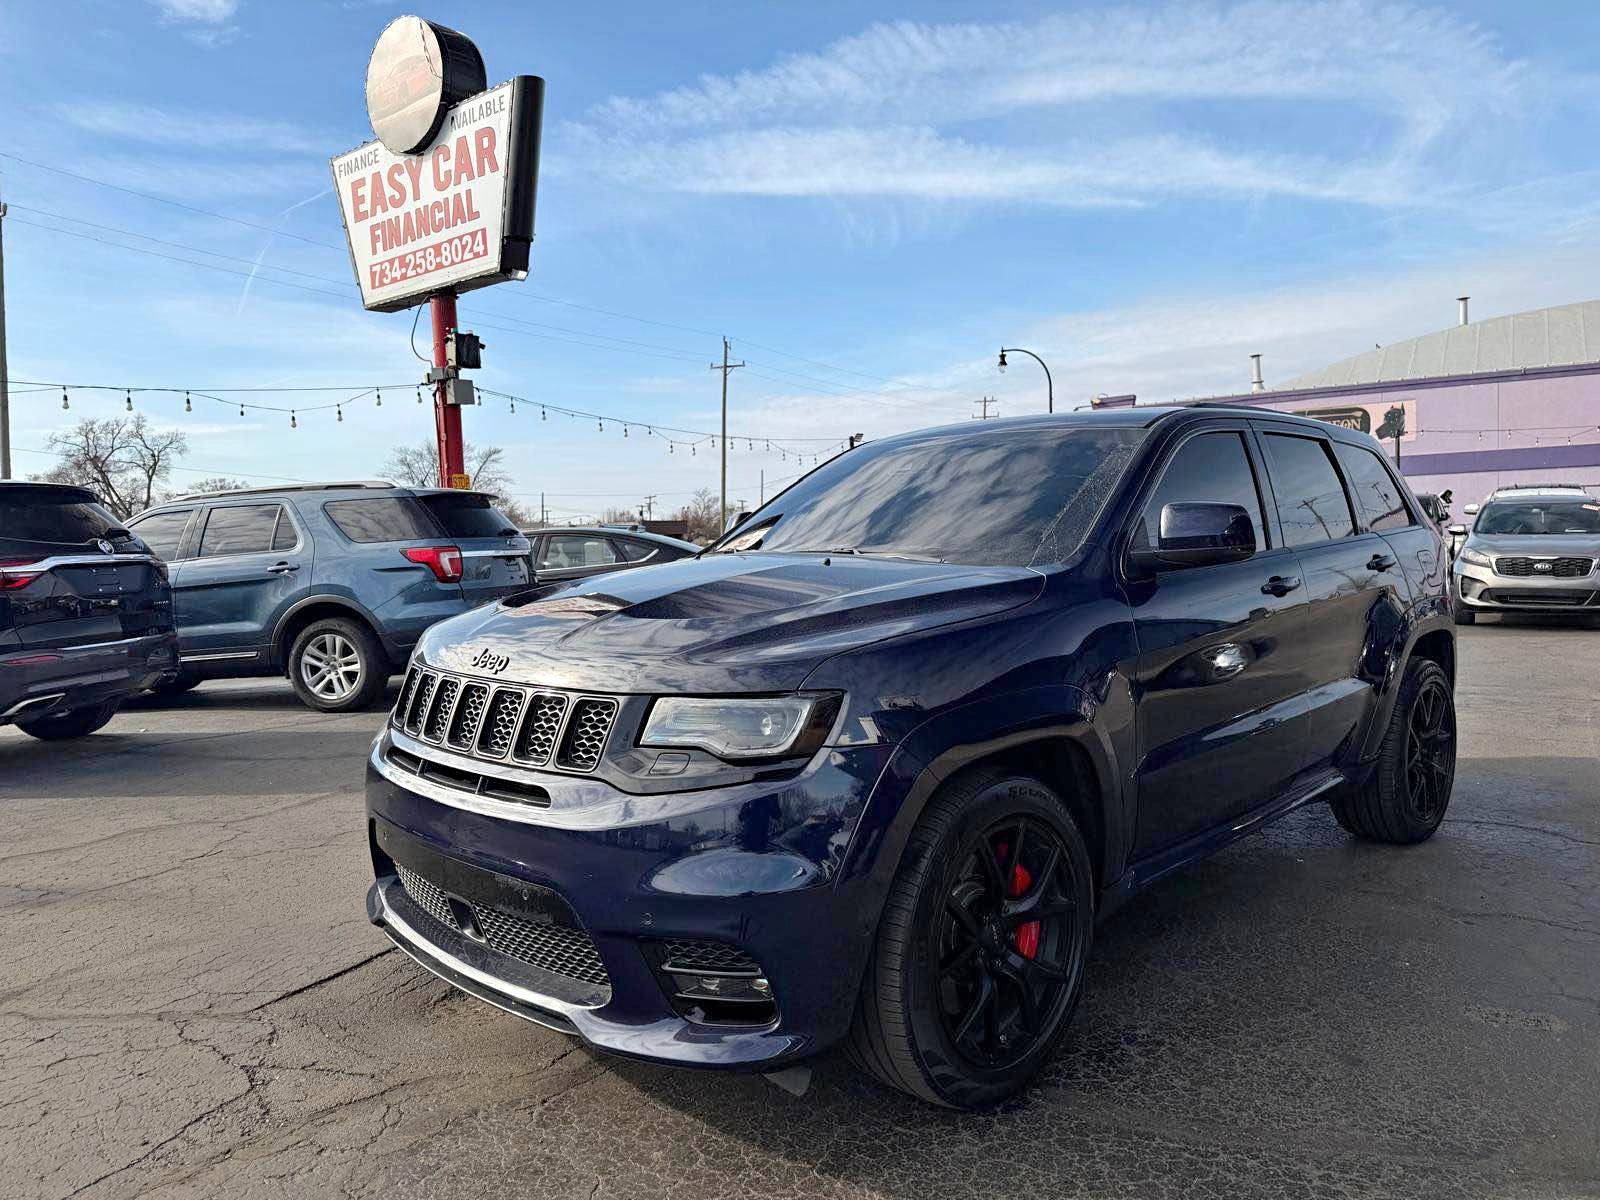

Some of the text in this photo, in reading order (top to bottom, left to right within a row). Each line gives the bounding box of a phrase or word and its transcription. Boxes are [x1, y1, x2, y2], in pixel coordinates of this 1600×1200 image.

[338, 95, 506, 178] FINANCE AVAILABLE
[351, 127, 499, 223] EASY CAR
[369, 189, 481, 256] FINANCIAL
[371, 231, 485, 287] 734-258-8024
[471, 648, 510, 675] Jeep
